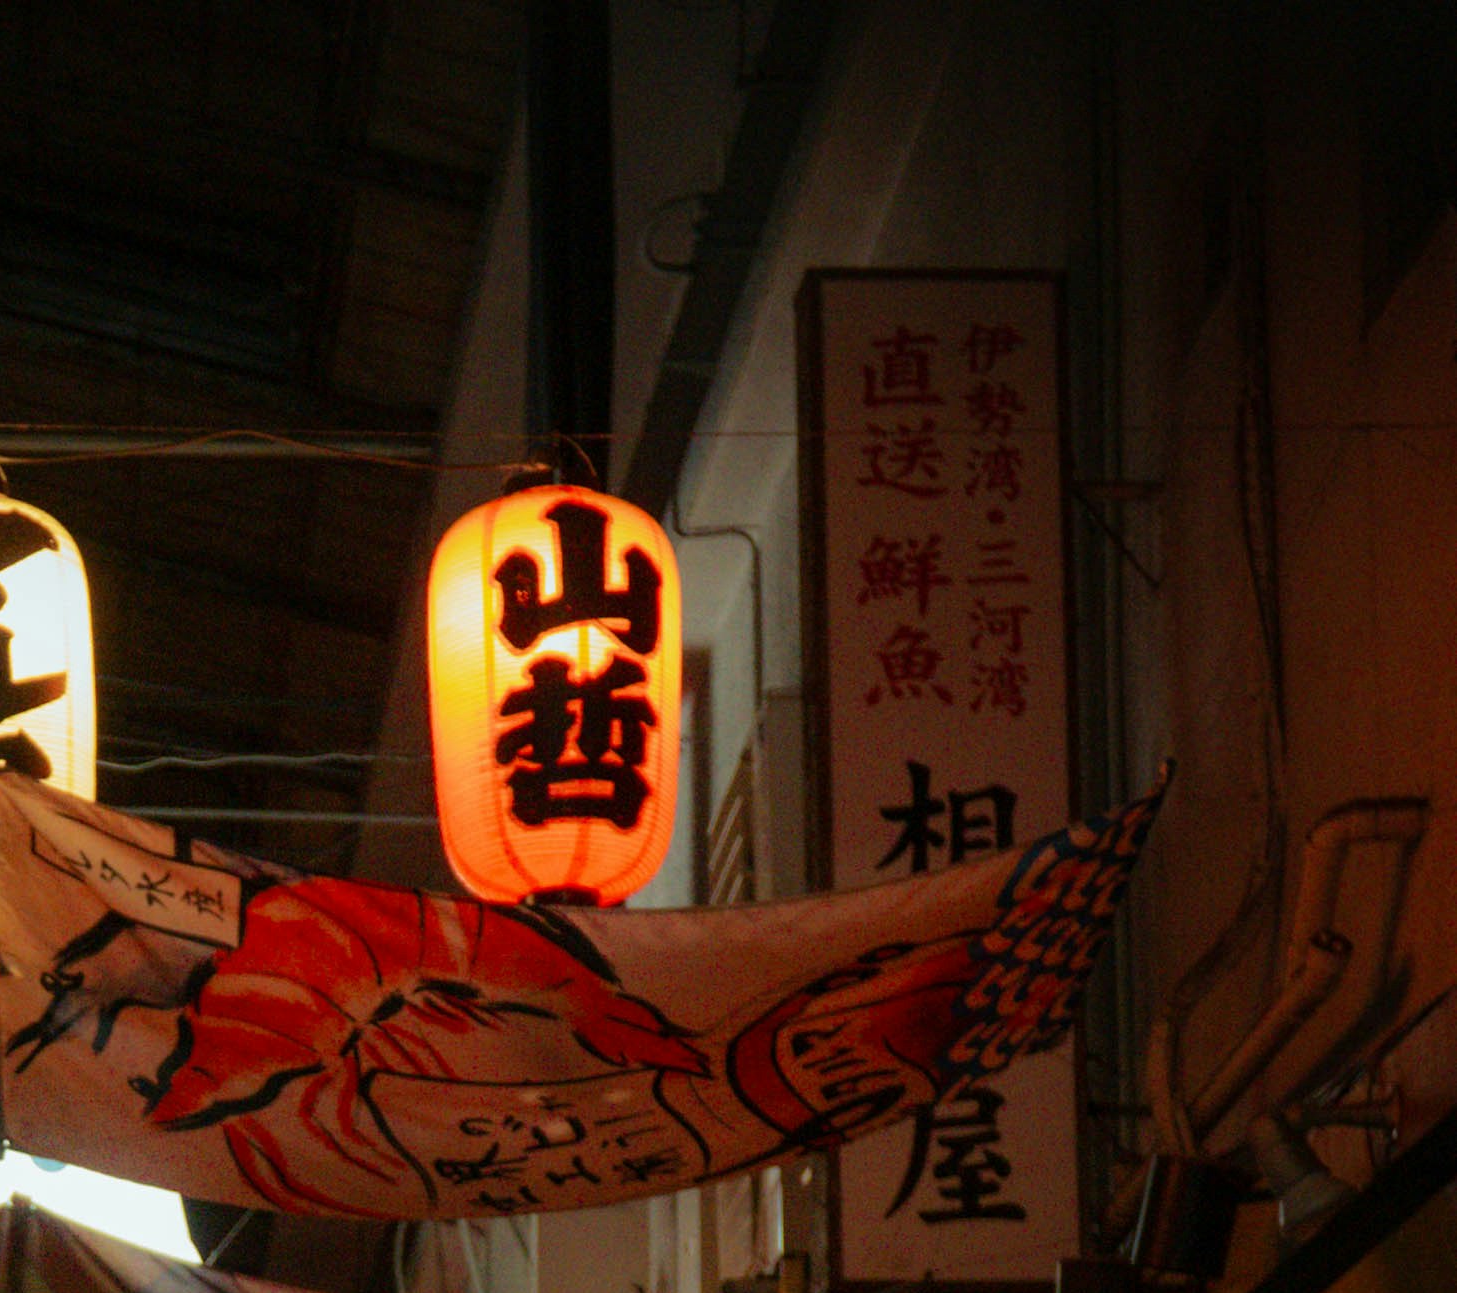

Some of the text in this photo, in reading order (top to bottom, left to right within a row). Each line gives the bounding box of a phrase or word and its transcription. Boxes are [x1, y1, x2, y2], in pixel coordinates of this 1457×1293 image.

[494, 499, 663, 832] 山哲
[855, 325, 954, 708] 直送鮮魚
[872, 759, 1028, 1225] 相屋
